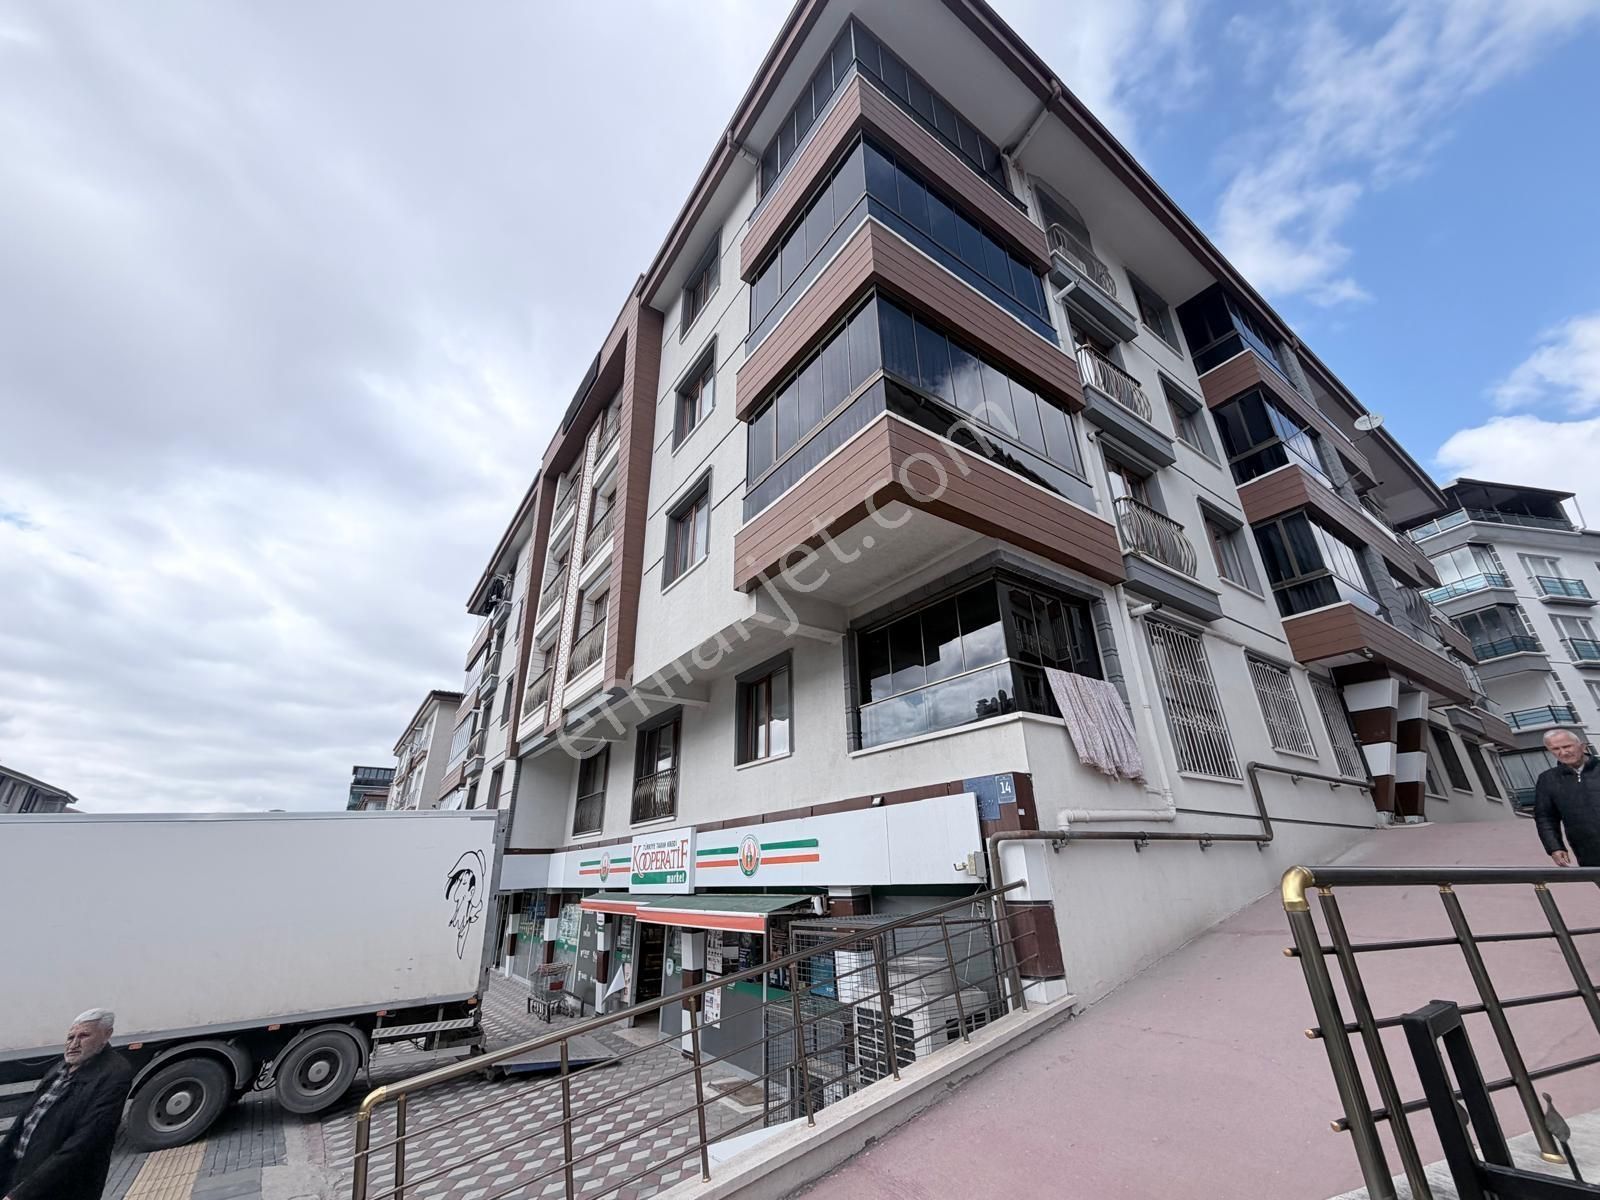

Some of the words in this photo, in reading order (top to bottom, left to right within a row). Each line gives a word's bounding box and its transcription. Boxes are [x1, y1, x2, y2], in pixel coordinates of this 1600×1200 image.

[1000, 782, 1011, 793] 14
[632, 839, 688, 878] KOOPERATİF
[666, 872, 685, 883] market
